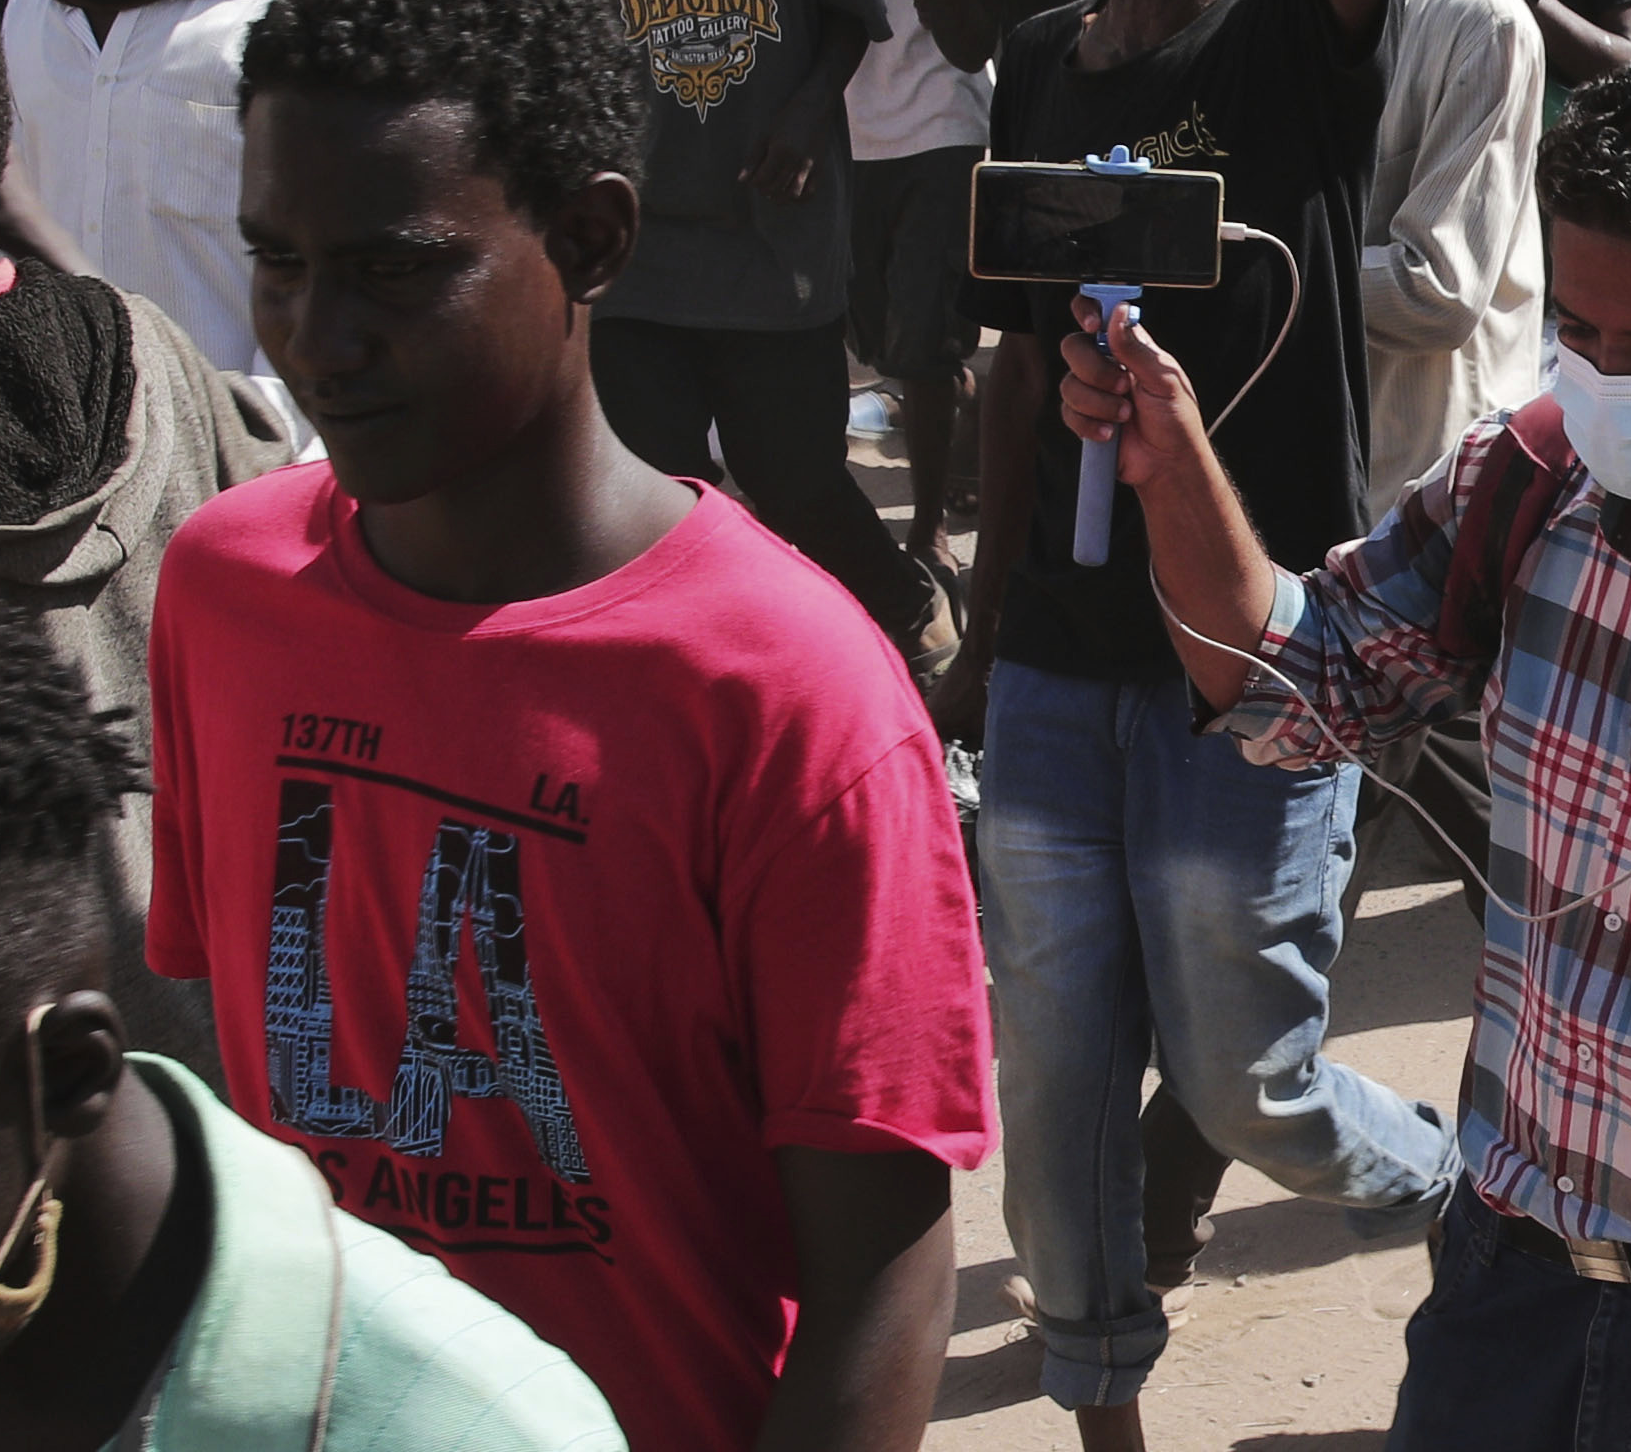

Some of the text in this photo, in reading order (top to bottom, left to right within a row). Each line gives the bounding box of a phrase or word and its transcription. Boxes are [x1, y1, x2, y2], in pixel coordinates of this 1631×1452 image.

[651, 16, 749, 46] TATTOO GALLERY
[279, 712, 383, 762] 137TH
[529, 772, 591, 826] LA.
[265, 778, 592, 1186] LA
[364, 1154, 616, 1245] ANGELES
